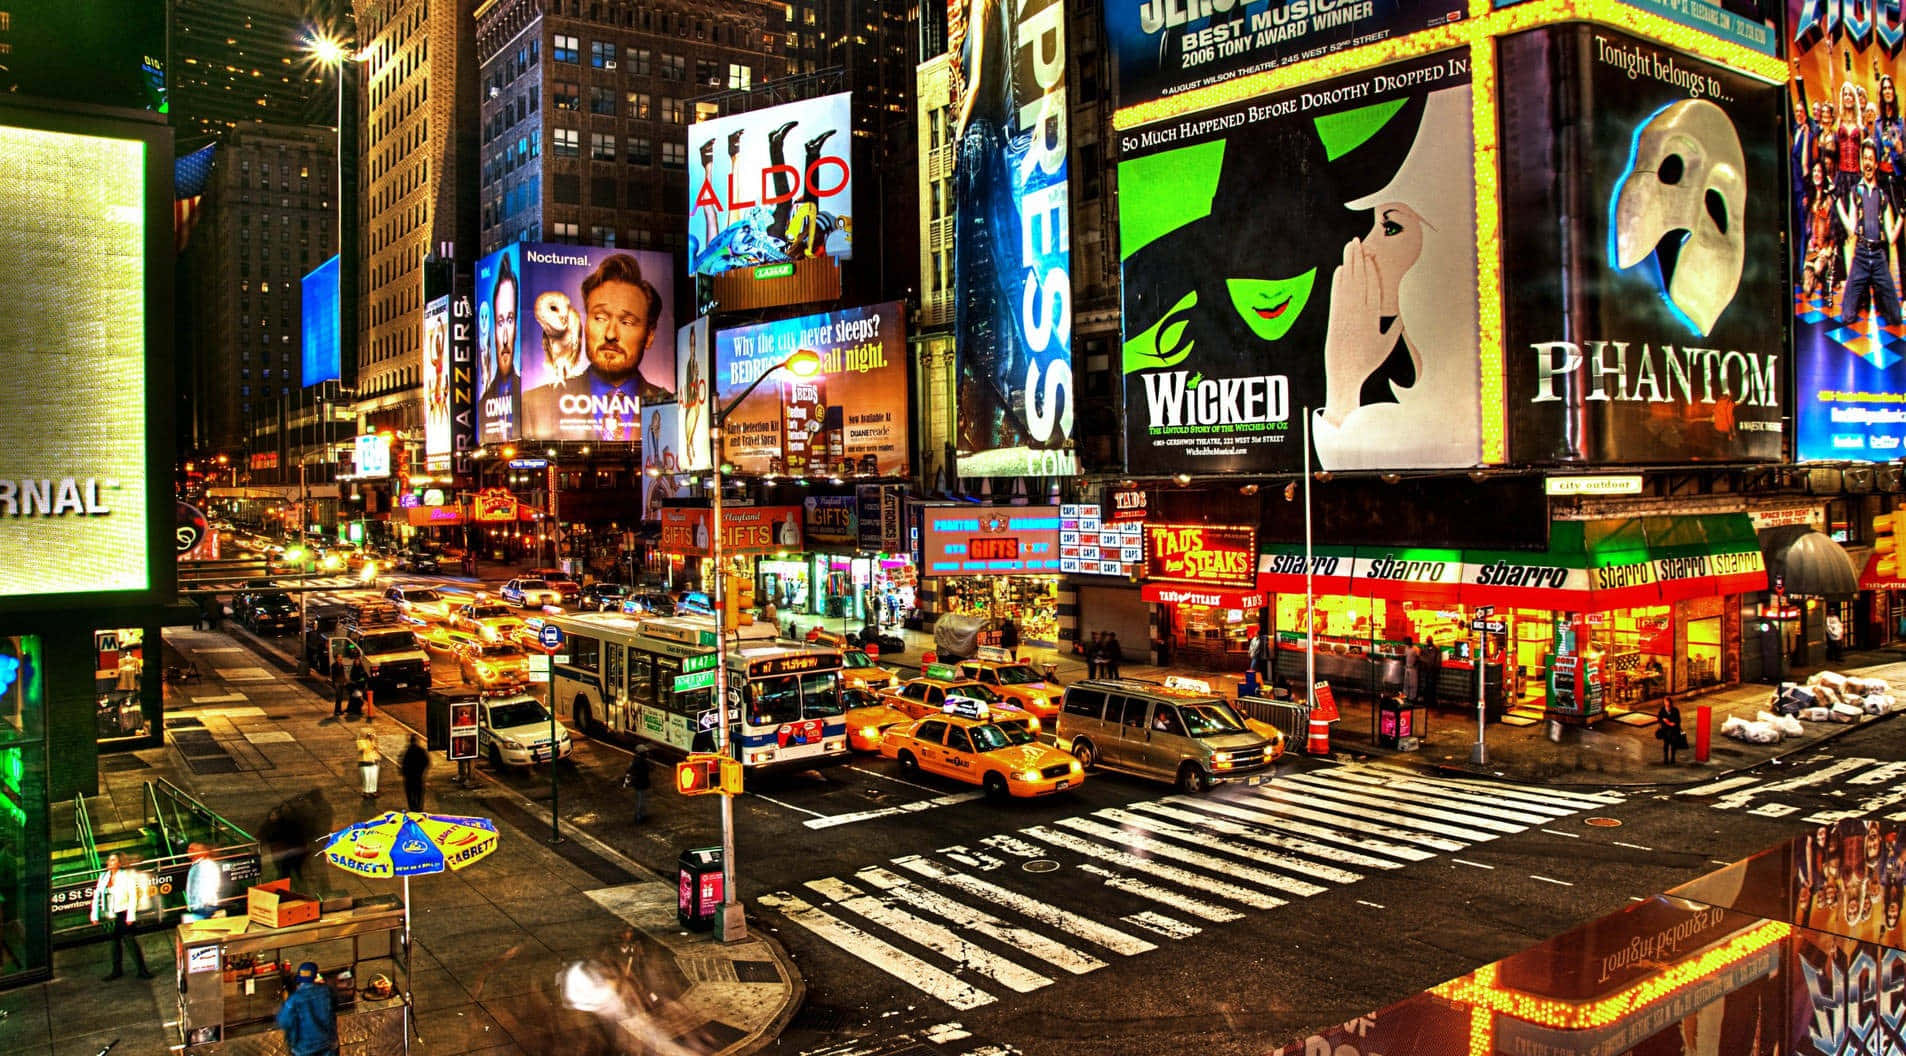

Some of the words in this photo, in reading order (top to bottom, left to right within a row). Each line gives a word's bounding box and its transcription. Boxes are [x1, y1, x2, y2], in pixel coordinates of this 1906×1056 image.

[1182, 18, 1245, 52] BEST
[1182, 46, 1215, 69] 2006
[1217, 34, 1252, 58] TONY
[1256, 20, 1307, 48] AWARD
[1312, 1, 1374, 32] WINNER
[1168, 79, 1201, 95] AUGUST
[1203, 70, 1236, 86] WILSON
[1301, 46, 1328, 60] WEST
[1352, 29, 1390, 47] STREET
[1594, 35, 1651, 79] Tonight
[1653, 52, 1705, 98] belongs
[689, 156, 850, 217] ALDO
[527, 250, 591, 267] Nocturnal.
[733, 335, 754, 357] Why
[757, 332, 775, 354] the
[800, 326, 832, 350] never
[835, 313, 881, 343] sleeps?
[823, 347, 841, 374] all
[845, 341, 888, 374] night.
[1530, 340, 1779, 408] PHANTOM
[1586, 480, 1631, 489] outdoor
[814, 507, 850, 527] GIFTS
[663, 526, 693, 545] GIFTS
[971, 539, 1017, 560] GIFTS
[1717, 550, 1758, 575] sbarro
[1184, 550, 1248, 577] STEAKS
[1270, 552, 1340, 576] sbarro
[1367, 554, 1445, 581] sbarro
[1476, 559, 1569, 589] sbarro
[1600, 561, 1648, 590] sbarro
[1661, 555, 1706, 581] sbarro
[698, 655, 708, 667] 47
[331, 852, 389, 874] SABRETT
[448, 837, 495, 865] SABRETT
[51, 893, 66, 904] 49
[68, 890, 83, 901] St
[51, 899, 92, 913] Downtow
